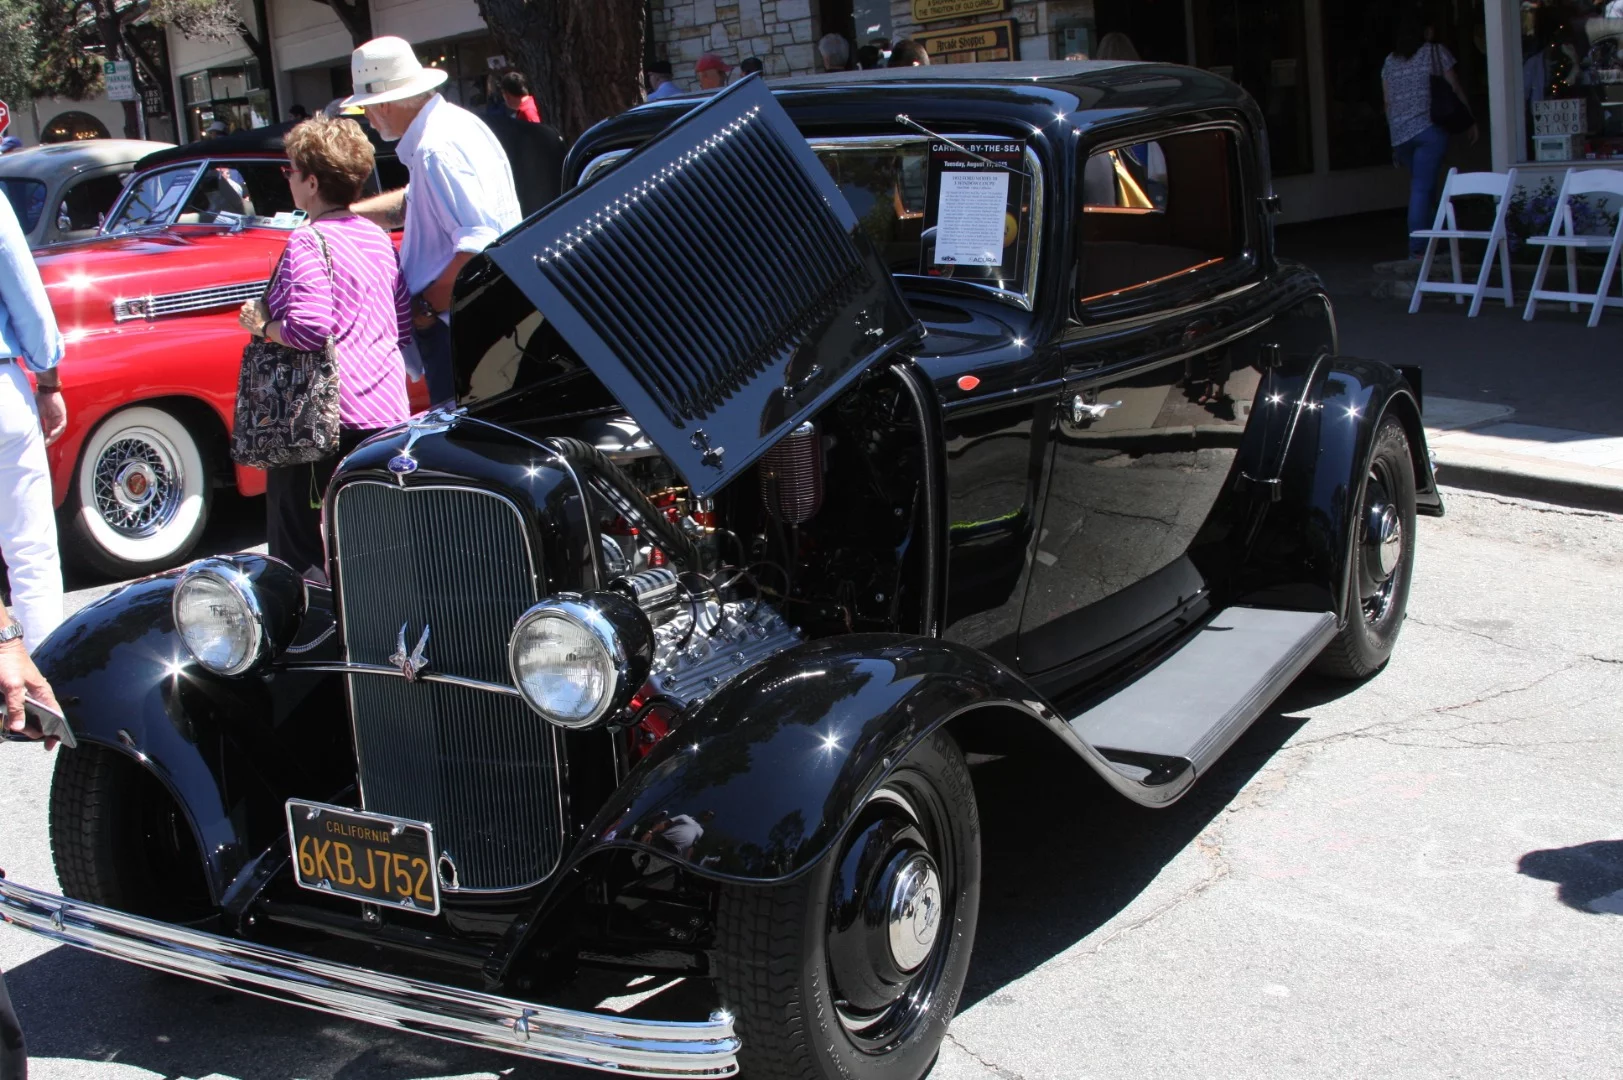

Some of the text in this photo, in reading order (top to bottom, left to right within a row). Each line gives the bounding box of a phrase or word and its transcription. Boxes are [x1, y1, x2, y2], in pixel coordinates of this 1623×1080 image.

[918, 8, 928, 16] THE
[936, 35, 986, 52] Arcade Shoppes
[106, 63, 114, 73] 2
[1535, 101, 1578, 111] ENJOY
[1544, 113, 1578, 122] YOUR
[932, 144, 1020, 152] CARM-BY-THE-SEA
[326, 820, 390, 844] CALIFORNIA
[299, 835, 433, 902] 6KBJ752
